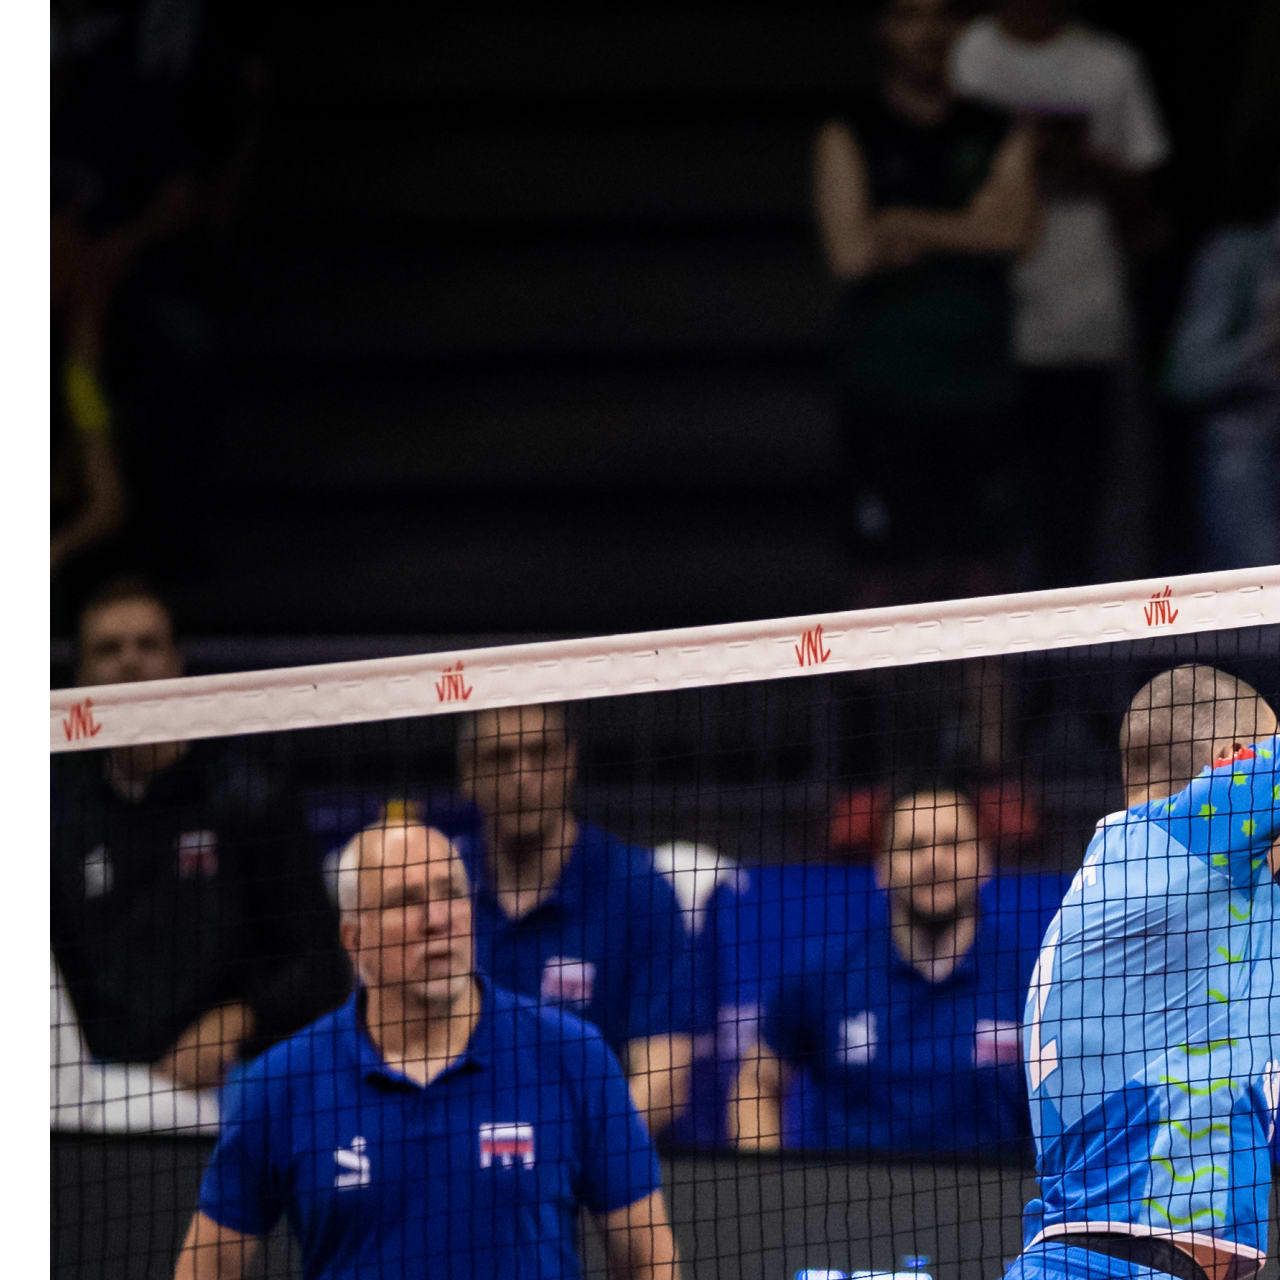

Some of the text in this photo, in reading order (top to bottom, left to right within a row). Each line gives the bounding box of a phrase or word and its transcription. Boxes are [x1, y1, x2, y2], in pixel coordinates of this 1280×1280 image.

[1144, 586, 1178, 627] VNL
[795, 624, 831, 667] VNL
[435, 659, 472, 702] VNL
